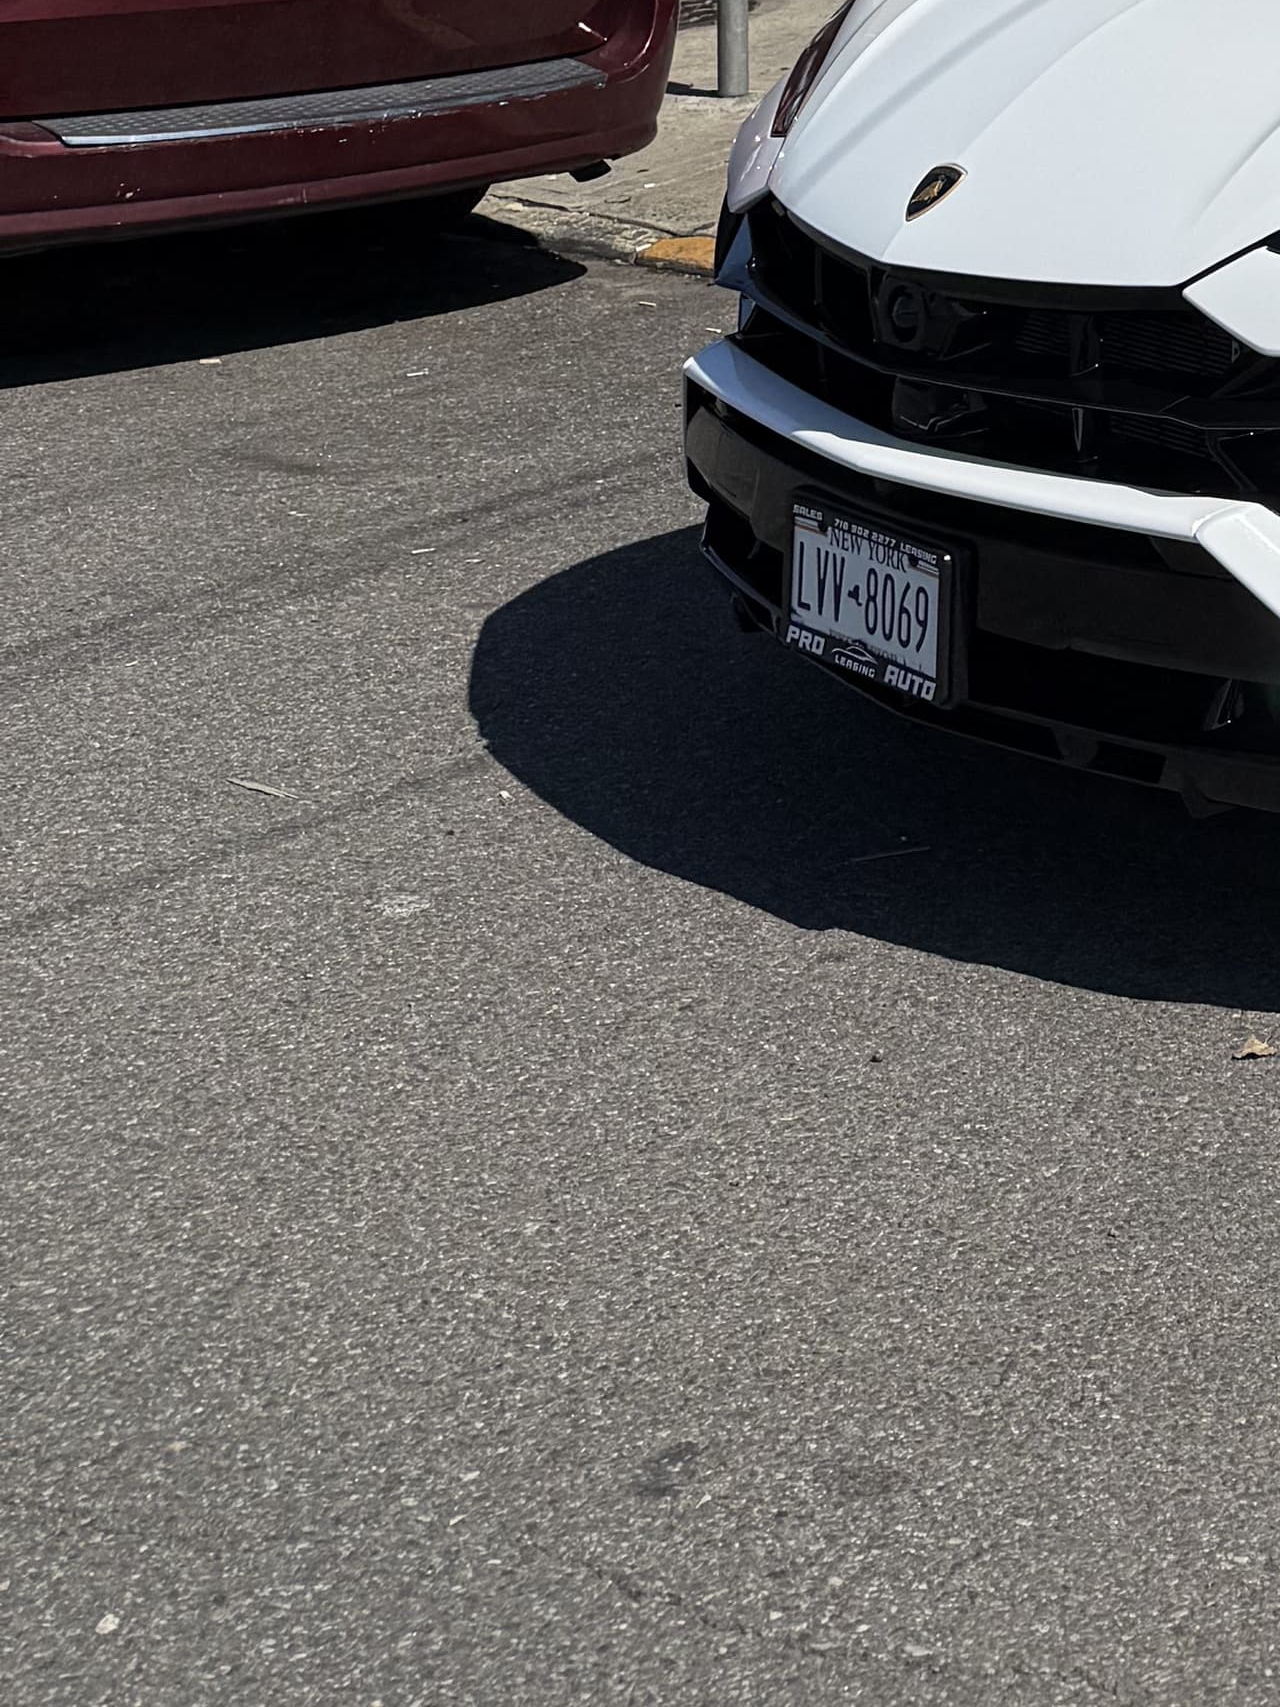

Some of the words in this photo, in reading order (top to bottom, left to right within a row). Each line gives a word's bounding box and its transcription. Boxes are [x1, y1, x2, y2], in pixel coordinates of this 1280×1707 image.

[792, 504, 823, 521] SALES
[828, 526, 863, 555] NEW
[868, 537, 906, 573] YORK
[900, 542, 937, 565] LEASING
[798, 542, 846, 622] LVV
[865, 567, 928, 652] 8069
[786, 624, 826, 656] PRO
[834, 654, 876, 679] LEASING
[884, 664, 937, 702] AUTO
